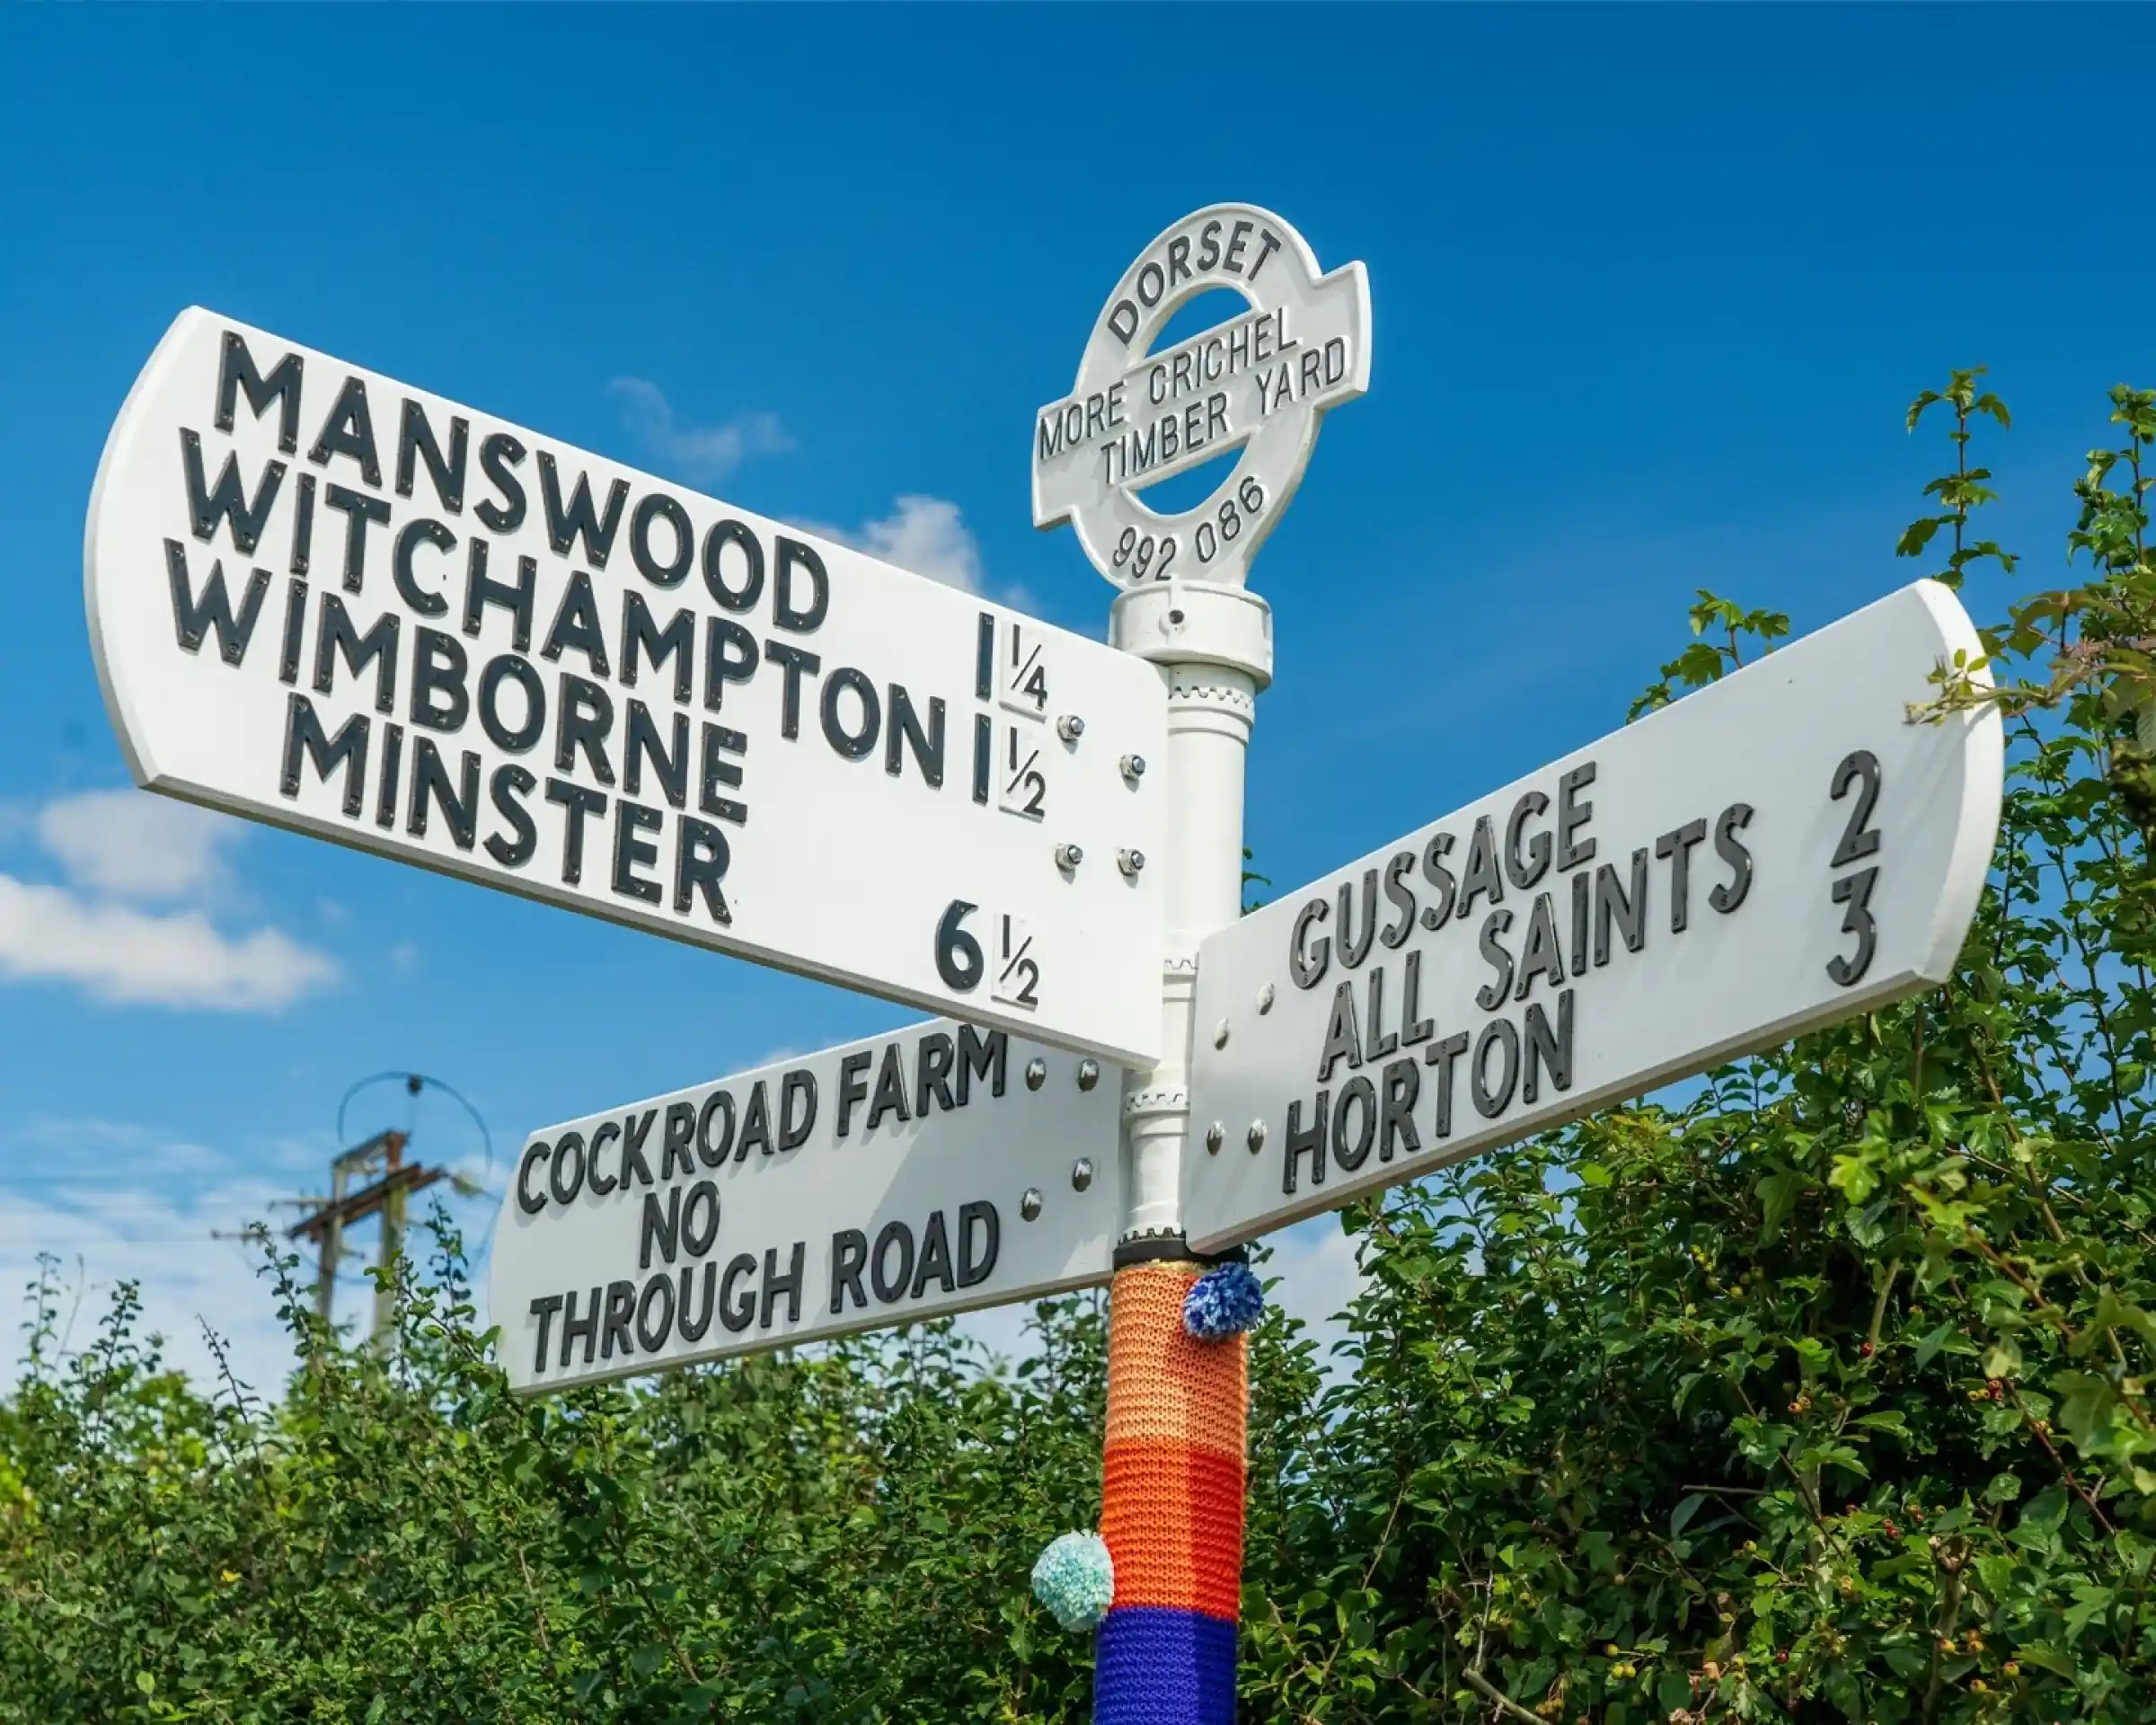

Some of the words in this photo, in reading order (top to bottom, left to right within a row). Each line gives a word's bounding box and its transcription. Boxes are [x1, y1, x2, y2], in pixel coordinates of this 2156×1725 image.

[1038, 380, 1126, 460] MORE
[1149, 307, 1298, 404] CRICHEL
[1108, 220, 1281, 345] DORSET
[214, 331, 829, 633] MANSWOOD
[1100, 392, 1228, 484] TIMBER
[1256, 335, 1345, 415] YARD
[180, 427, 946, 789] WITCHAMPTON
[1113, 526, 1175, 581] 992
[1195, 475, 1265, 563] 086
[163, 537, 748, 823] WIMBORNE
[280, 692, 732, 924] MINSTER
[1289, 760, 1596, 989] GUSSAGE
[1317, 949, 1434, 1082] ALL
[1475, 803, 1754, 1012] SAINTS
[1830, 749, 1881, 868] 2
[517, 1068, 818, 1215] COCKROAD
[836, 1023, 1008, 1137] FARM
[1283, 989, 1574, 1195] HORTON
[1825, 866, 1879, 986] 3
[530, 1241, 807, 1373] THROUGH
[828, 1199, 1000, 1314] ROAD
[640, 1181, 720, 1269] NO
